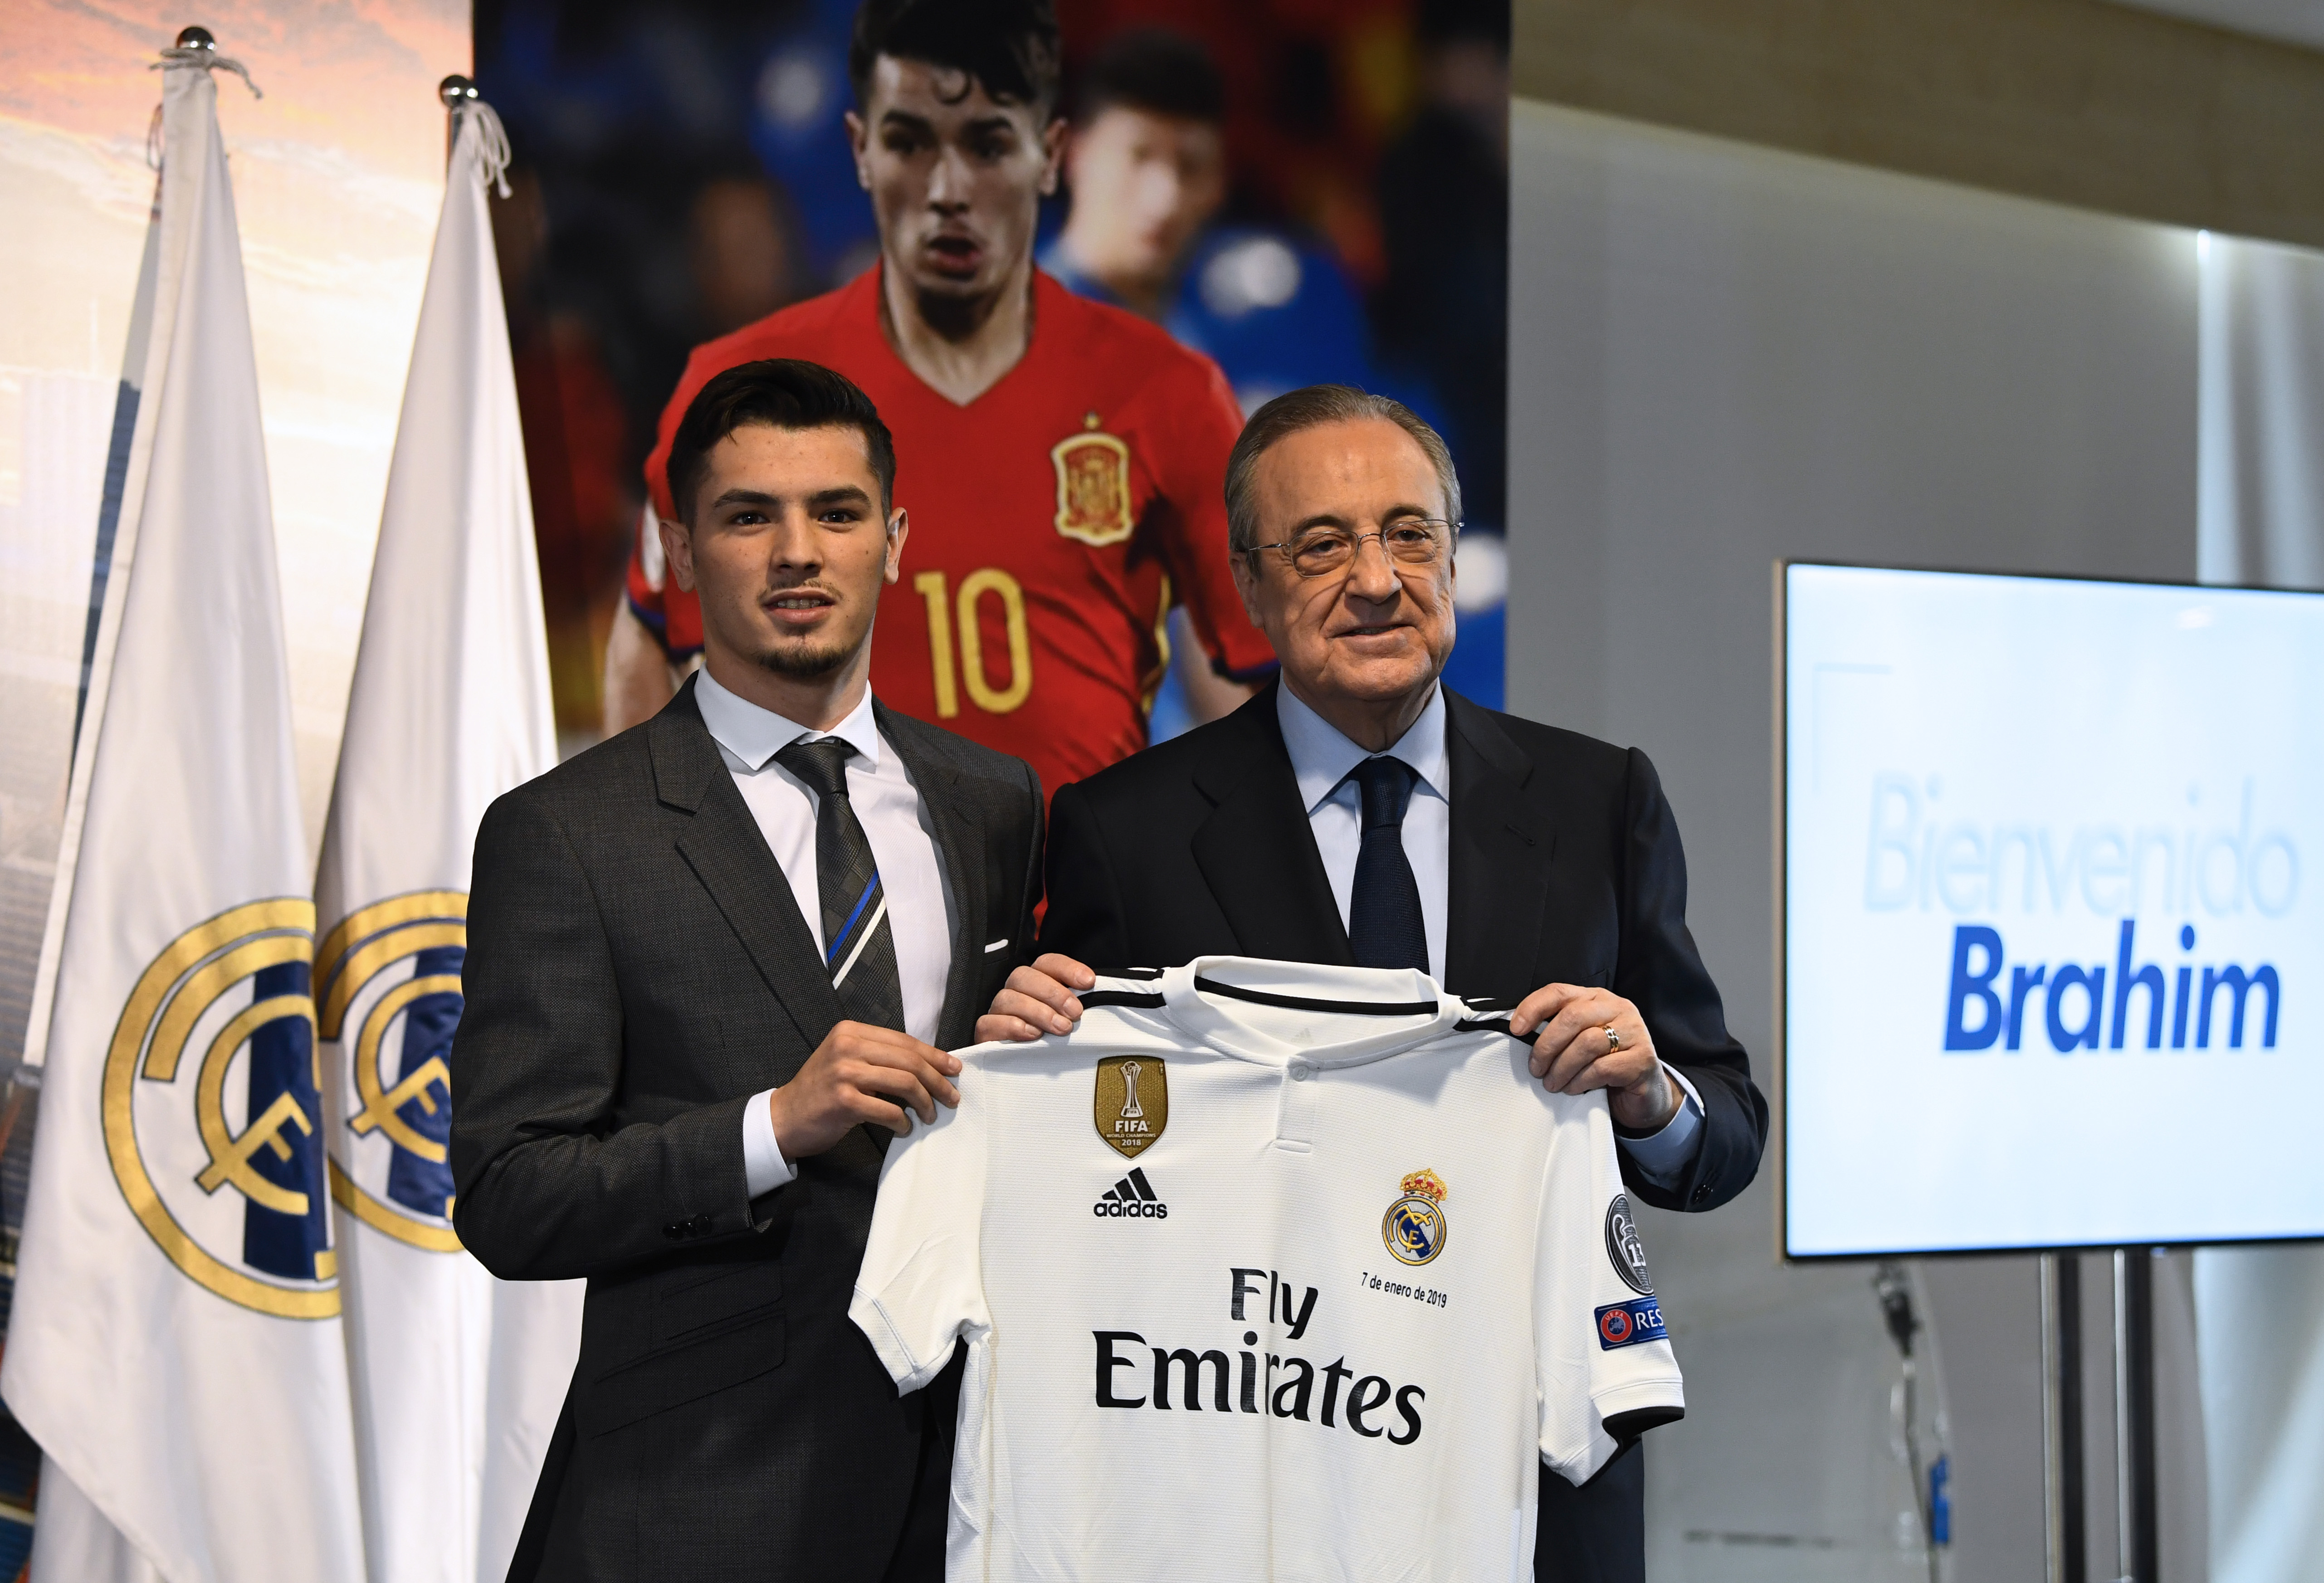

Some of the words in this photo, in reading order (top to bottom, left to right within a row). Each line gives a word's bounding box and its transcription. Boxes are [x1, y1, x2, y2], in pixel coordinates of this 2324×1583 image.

[915, 569, 1032, 718] 10
[1863, 770, 2301, 917] Bienvenido
[1943, 919, 2280, 1054] Brahim
[1094, 1197, 1167, 1219] adidas
[1230, 1268, 1318, 1340] Fly
[1362, 1272, 1368, 1286] 7
[1370, 1275, 1382, 1290] de
[1384, 1281, 1411, 1297] enero
[1414, 1286, 1425, 1301] de
[1426, 1289, 1447, 1308] 2019
[1605, 1311, 1624, 1320] UEFA
[1092, 1330, 1426, 1446] Emirates
